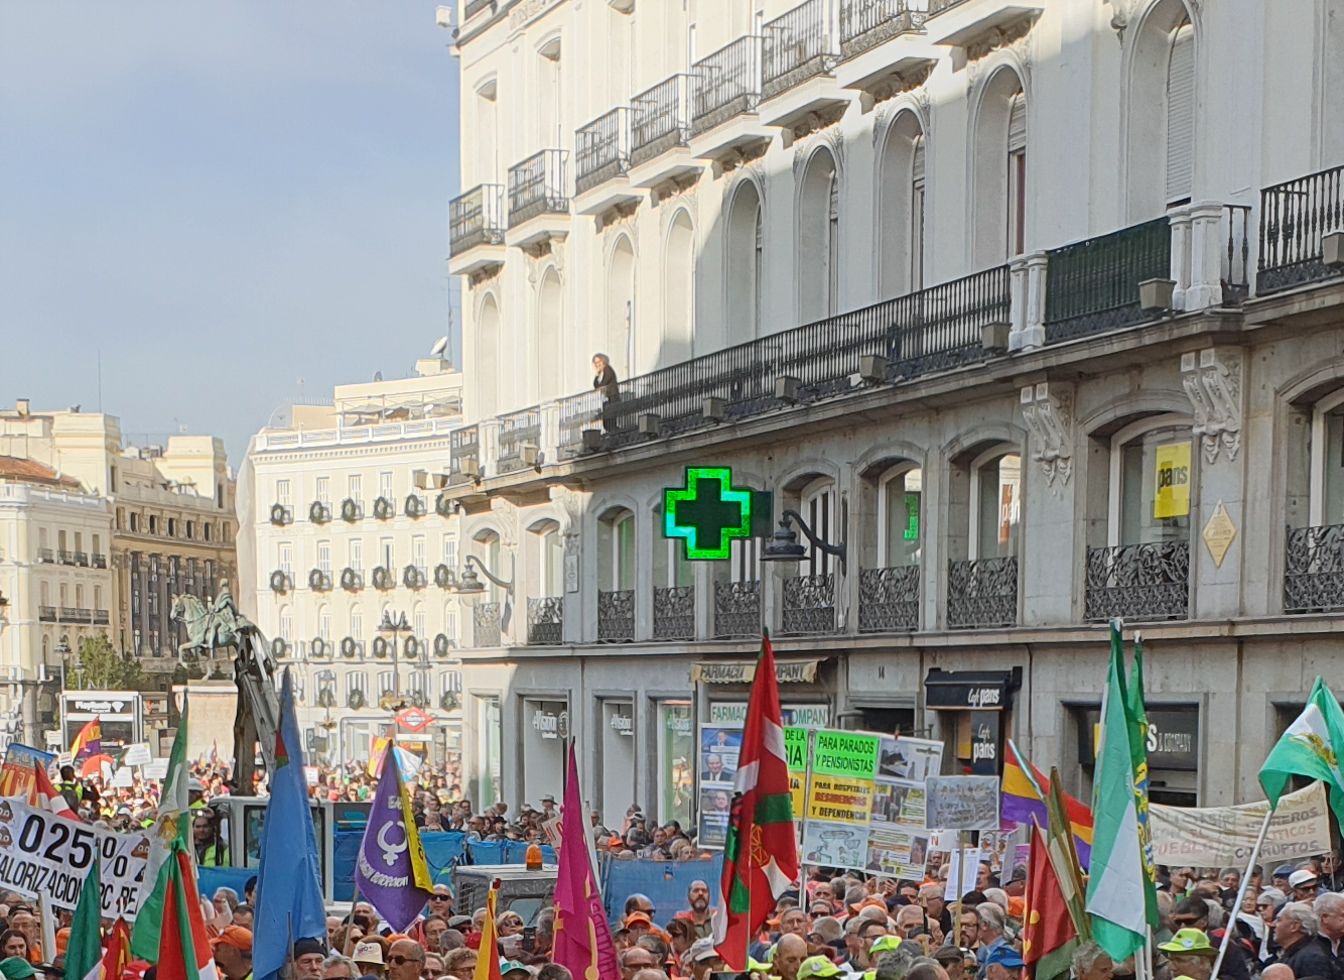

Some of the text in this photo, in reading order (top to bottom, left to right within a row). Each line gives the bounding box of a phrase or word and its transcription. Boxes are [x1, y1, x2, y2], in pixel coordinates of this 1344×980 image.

[1157, 464, 1188, 494] pans
[980, 688, 1001, 706] pans
[819, 736, 874, 755] PARA PARADOS
[973, 742, 996, 763] pans
[822, 755, 874, 773] PENSIONISTAS
